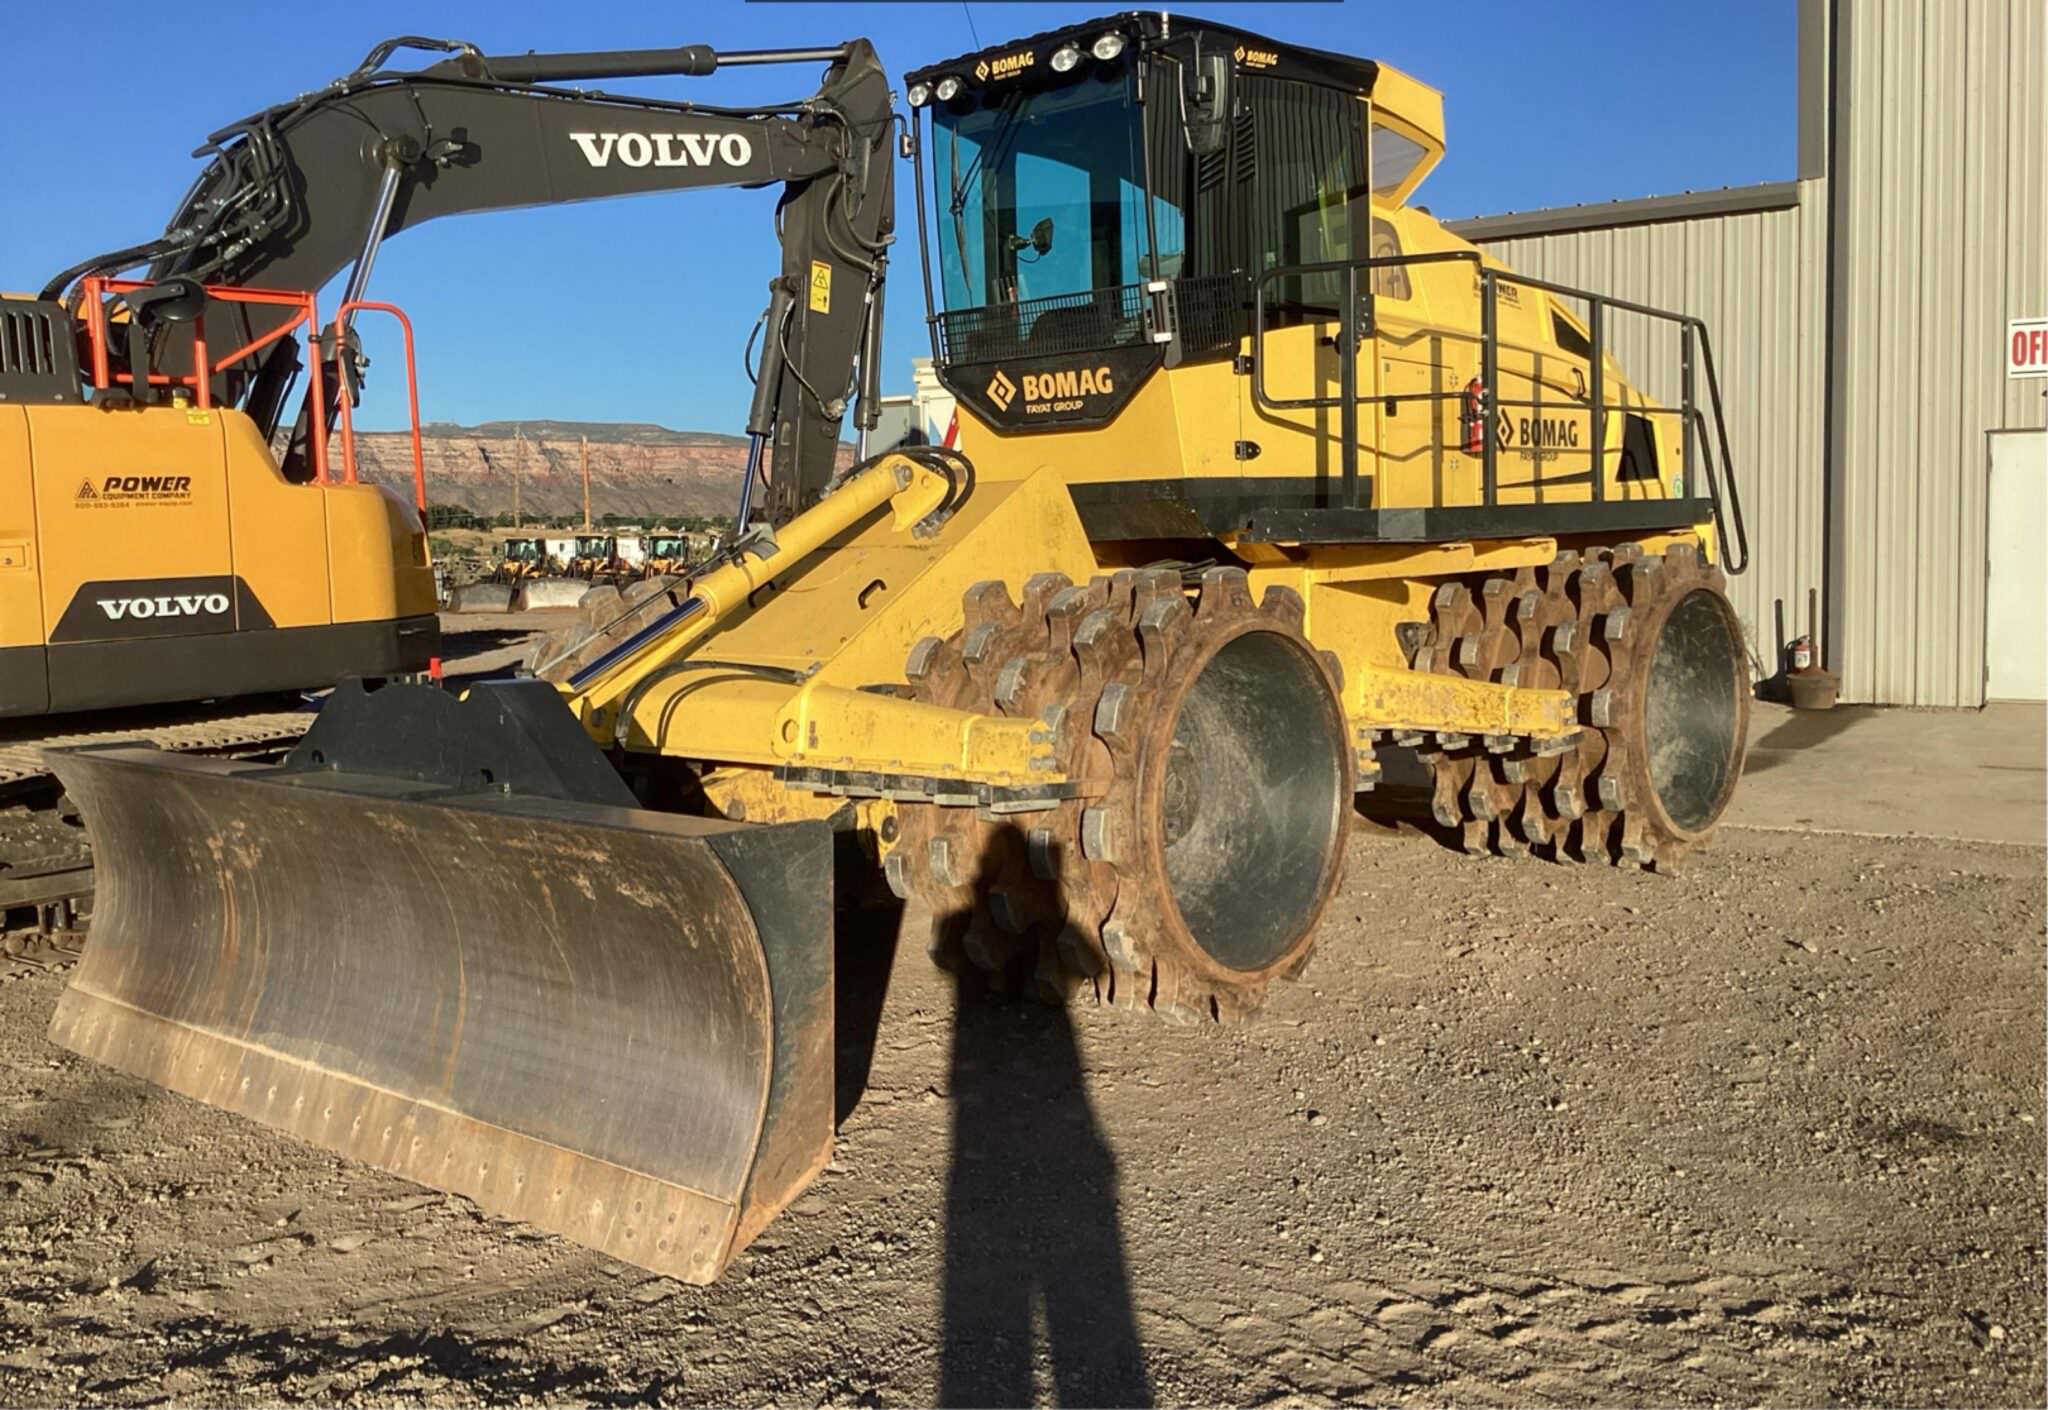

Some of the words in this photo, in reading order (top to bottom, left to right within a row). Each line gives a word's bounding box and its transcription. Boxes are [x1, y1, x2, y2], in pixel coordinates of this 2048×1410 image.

[992, 51, 1034, 75] BOMAG
[1247, 50, 1278, 65] BOMAG
[569, 132, 752, 168] VOLVO
[1022, 367, 1113, 401] BOMAG
[1026, 403, 1052, 415] FAYAT
[1053, 400, 1084, 412] GROUP
[1520, 418, 1578, 448] BOMAG
[103, 476, 192, 492] POWER
[103, 492, 150, 500] EQUIPMENT
[152, 492, 191, 500] COMPANY
[96, 594, 230, 620] VOLVO
